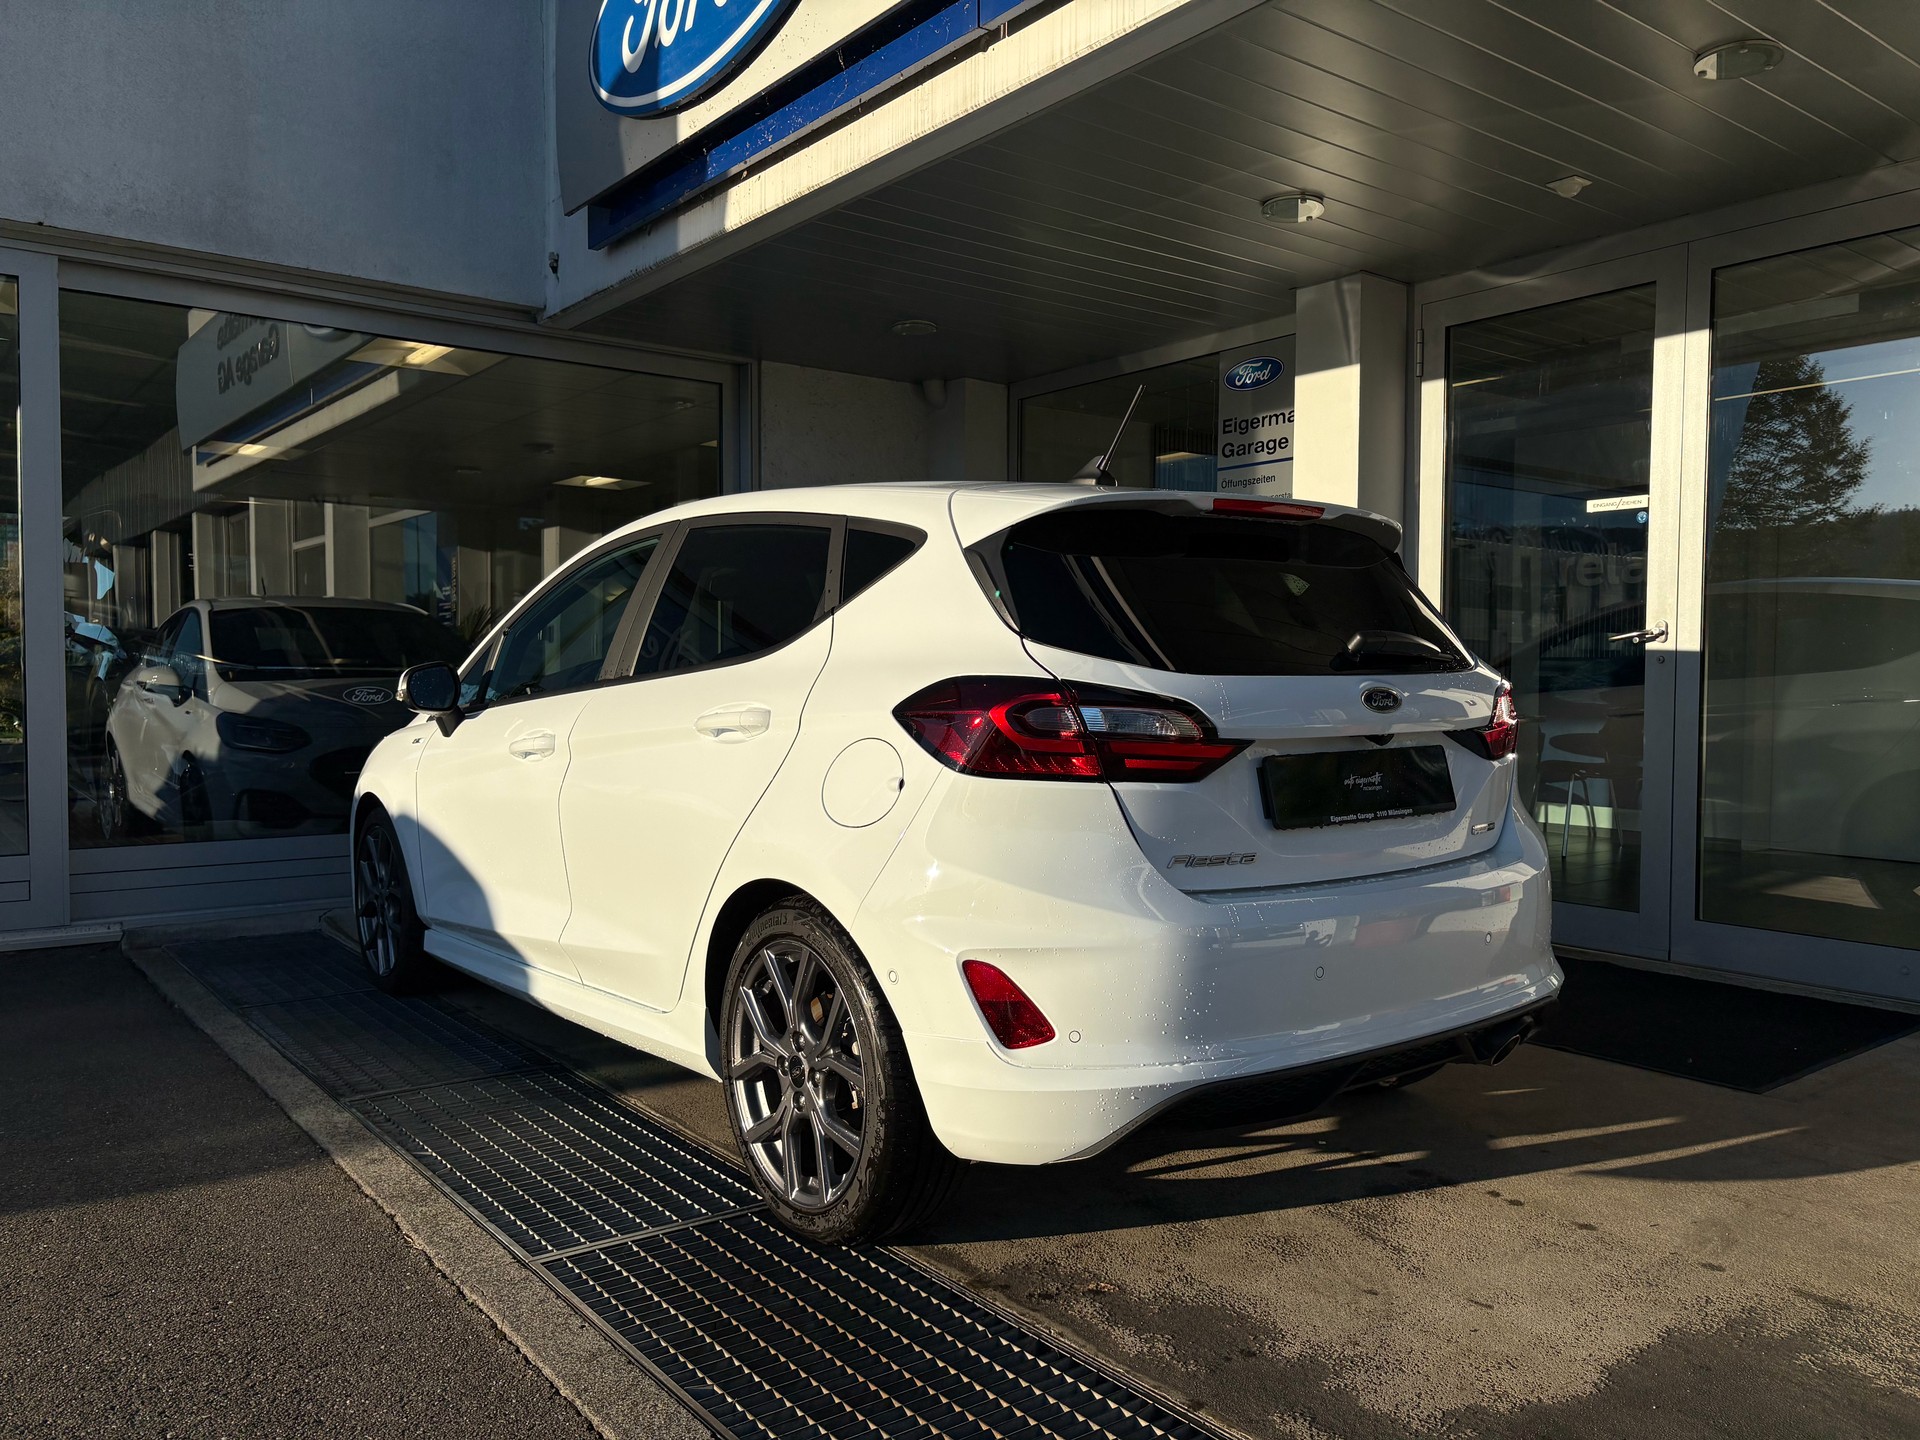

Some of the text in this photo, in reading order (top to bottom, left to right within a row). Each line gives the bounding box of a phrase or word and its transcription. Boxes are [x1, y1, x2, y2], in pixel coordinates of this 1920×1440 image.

[1235, 361, 1271, 387] Ford
[1221, 436, 1289, 459] Garage
[352, 688, 384, 702] Ford
[1372, 692, 1396, 706] Ford
[1330, 813, 1357, 823] Eigermatte
[1357, 812, 1375, 821] Garage
[1166, 852, 1258, 869] Fiesta
